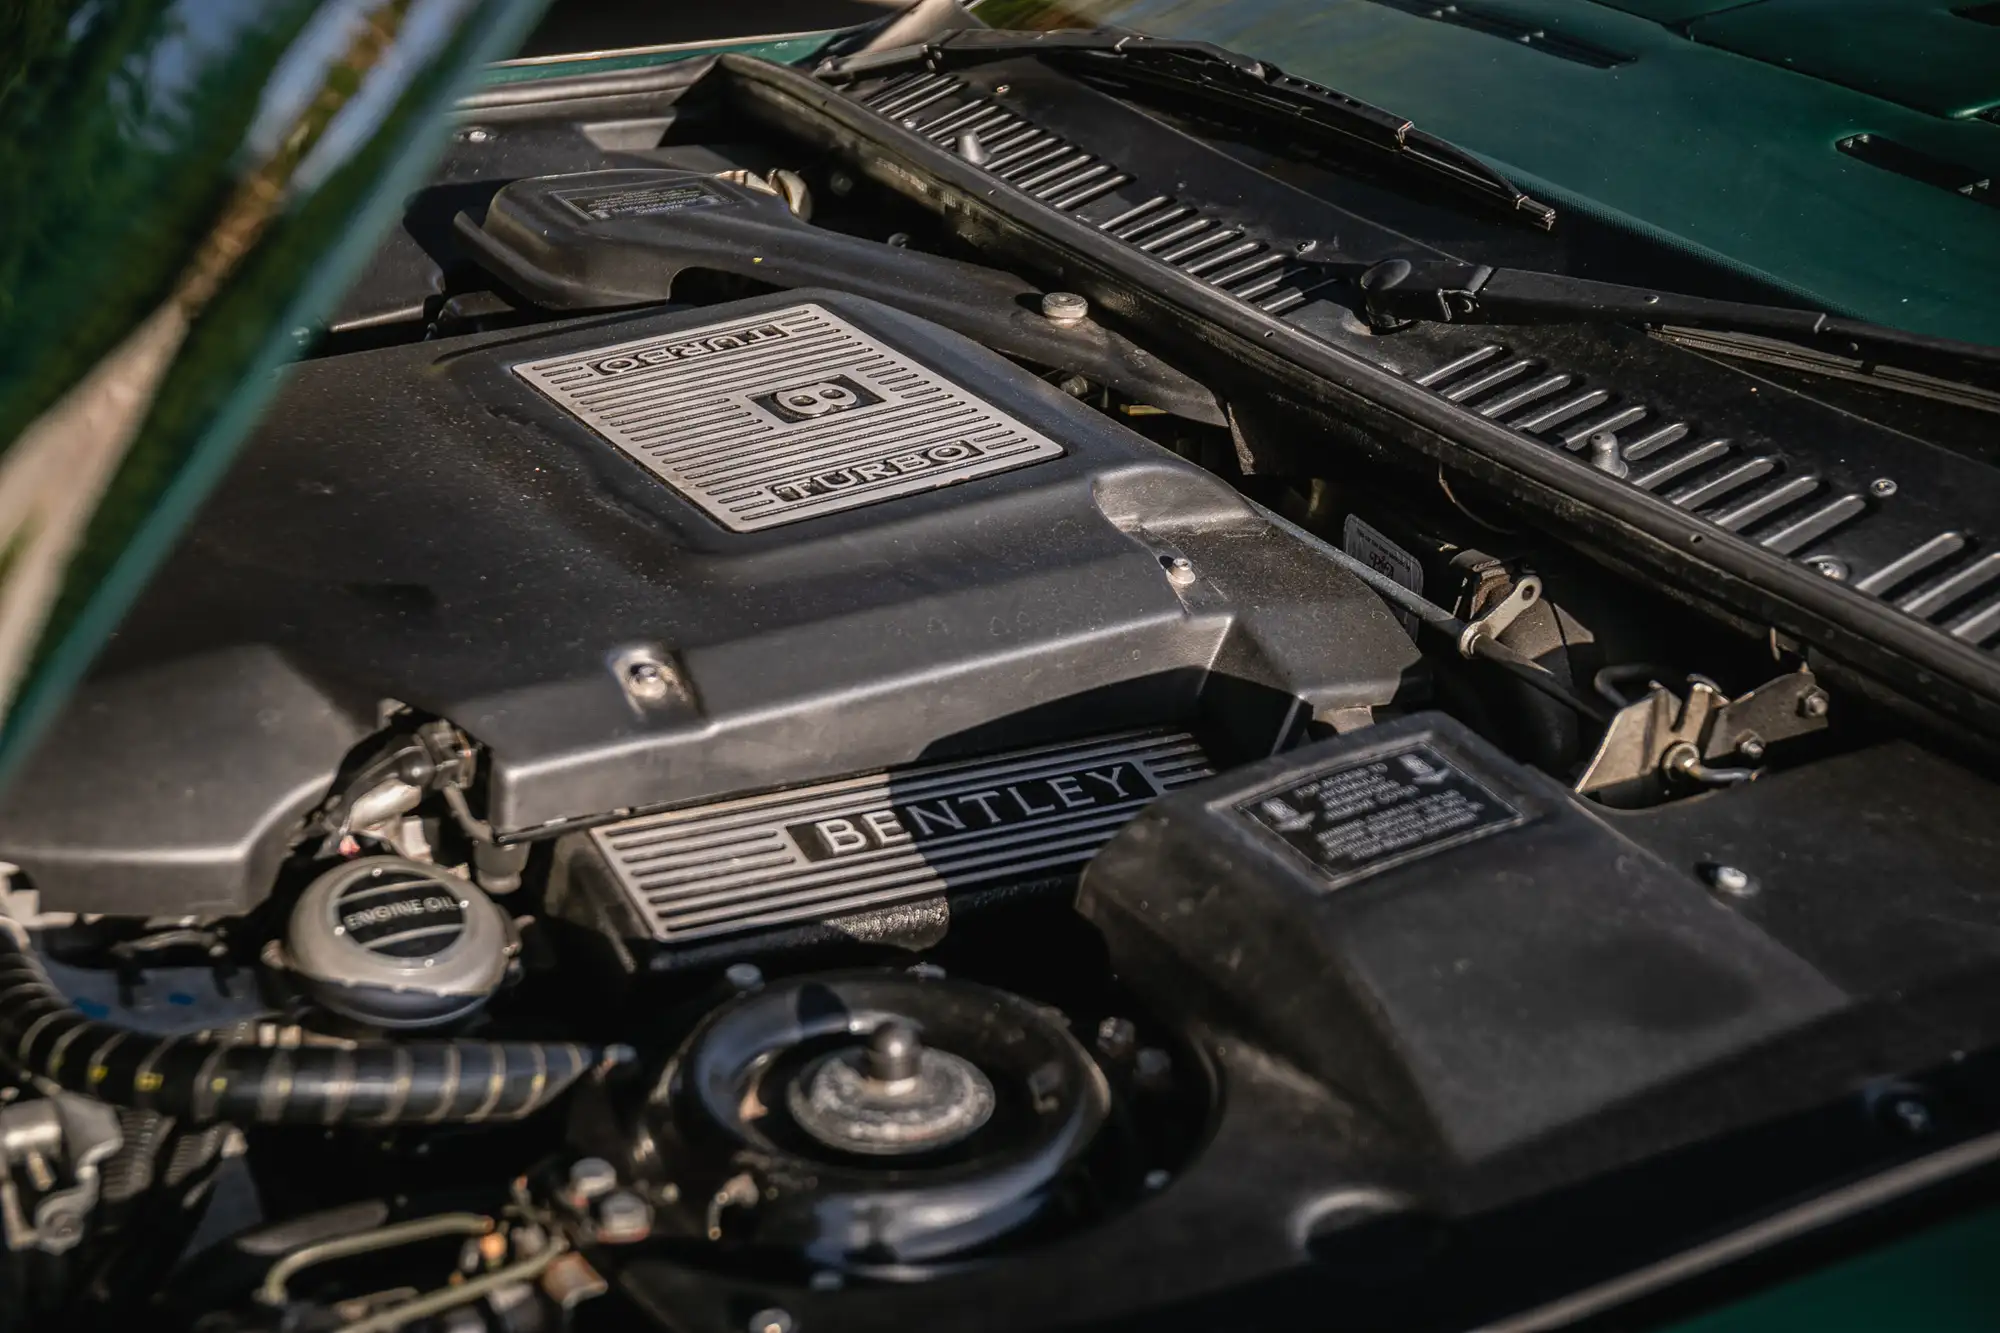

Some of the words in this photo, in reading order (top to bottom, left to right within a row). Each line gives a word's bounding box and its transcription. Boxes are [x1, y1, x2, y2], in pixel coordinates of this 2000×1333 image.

[600, 329, 783, 373] TURBO
[773, 444, 970, 498] TURBO
[815, 766, 1130, 856] BENTLEY
[343, 898, 424, 932] ENGINE
[423, 896, 460, 913] OIL
